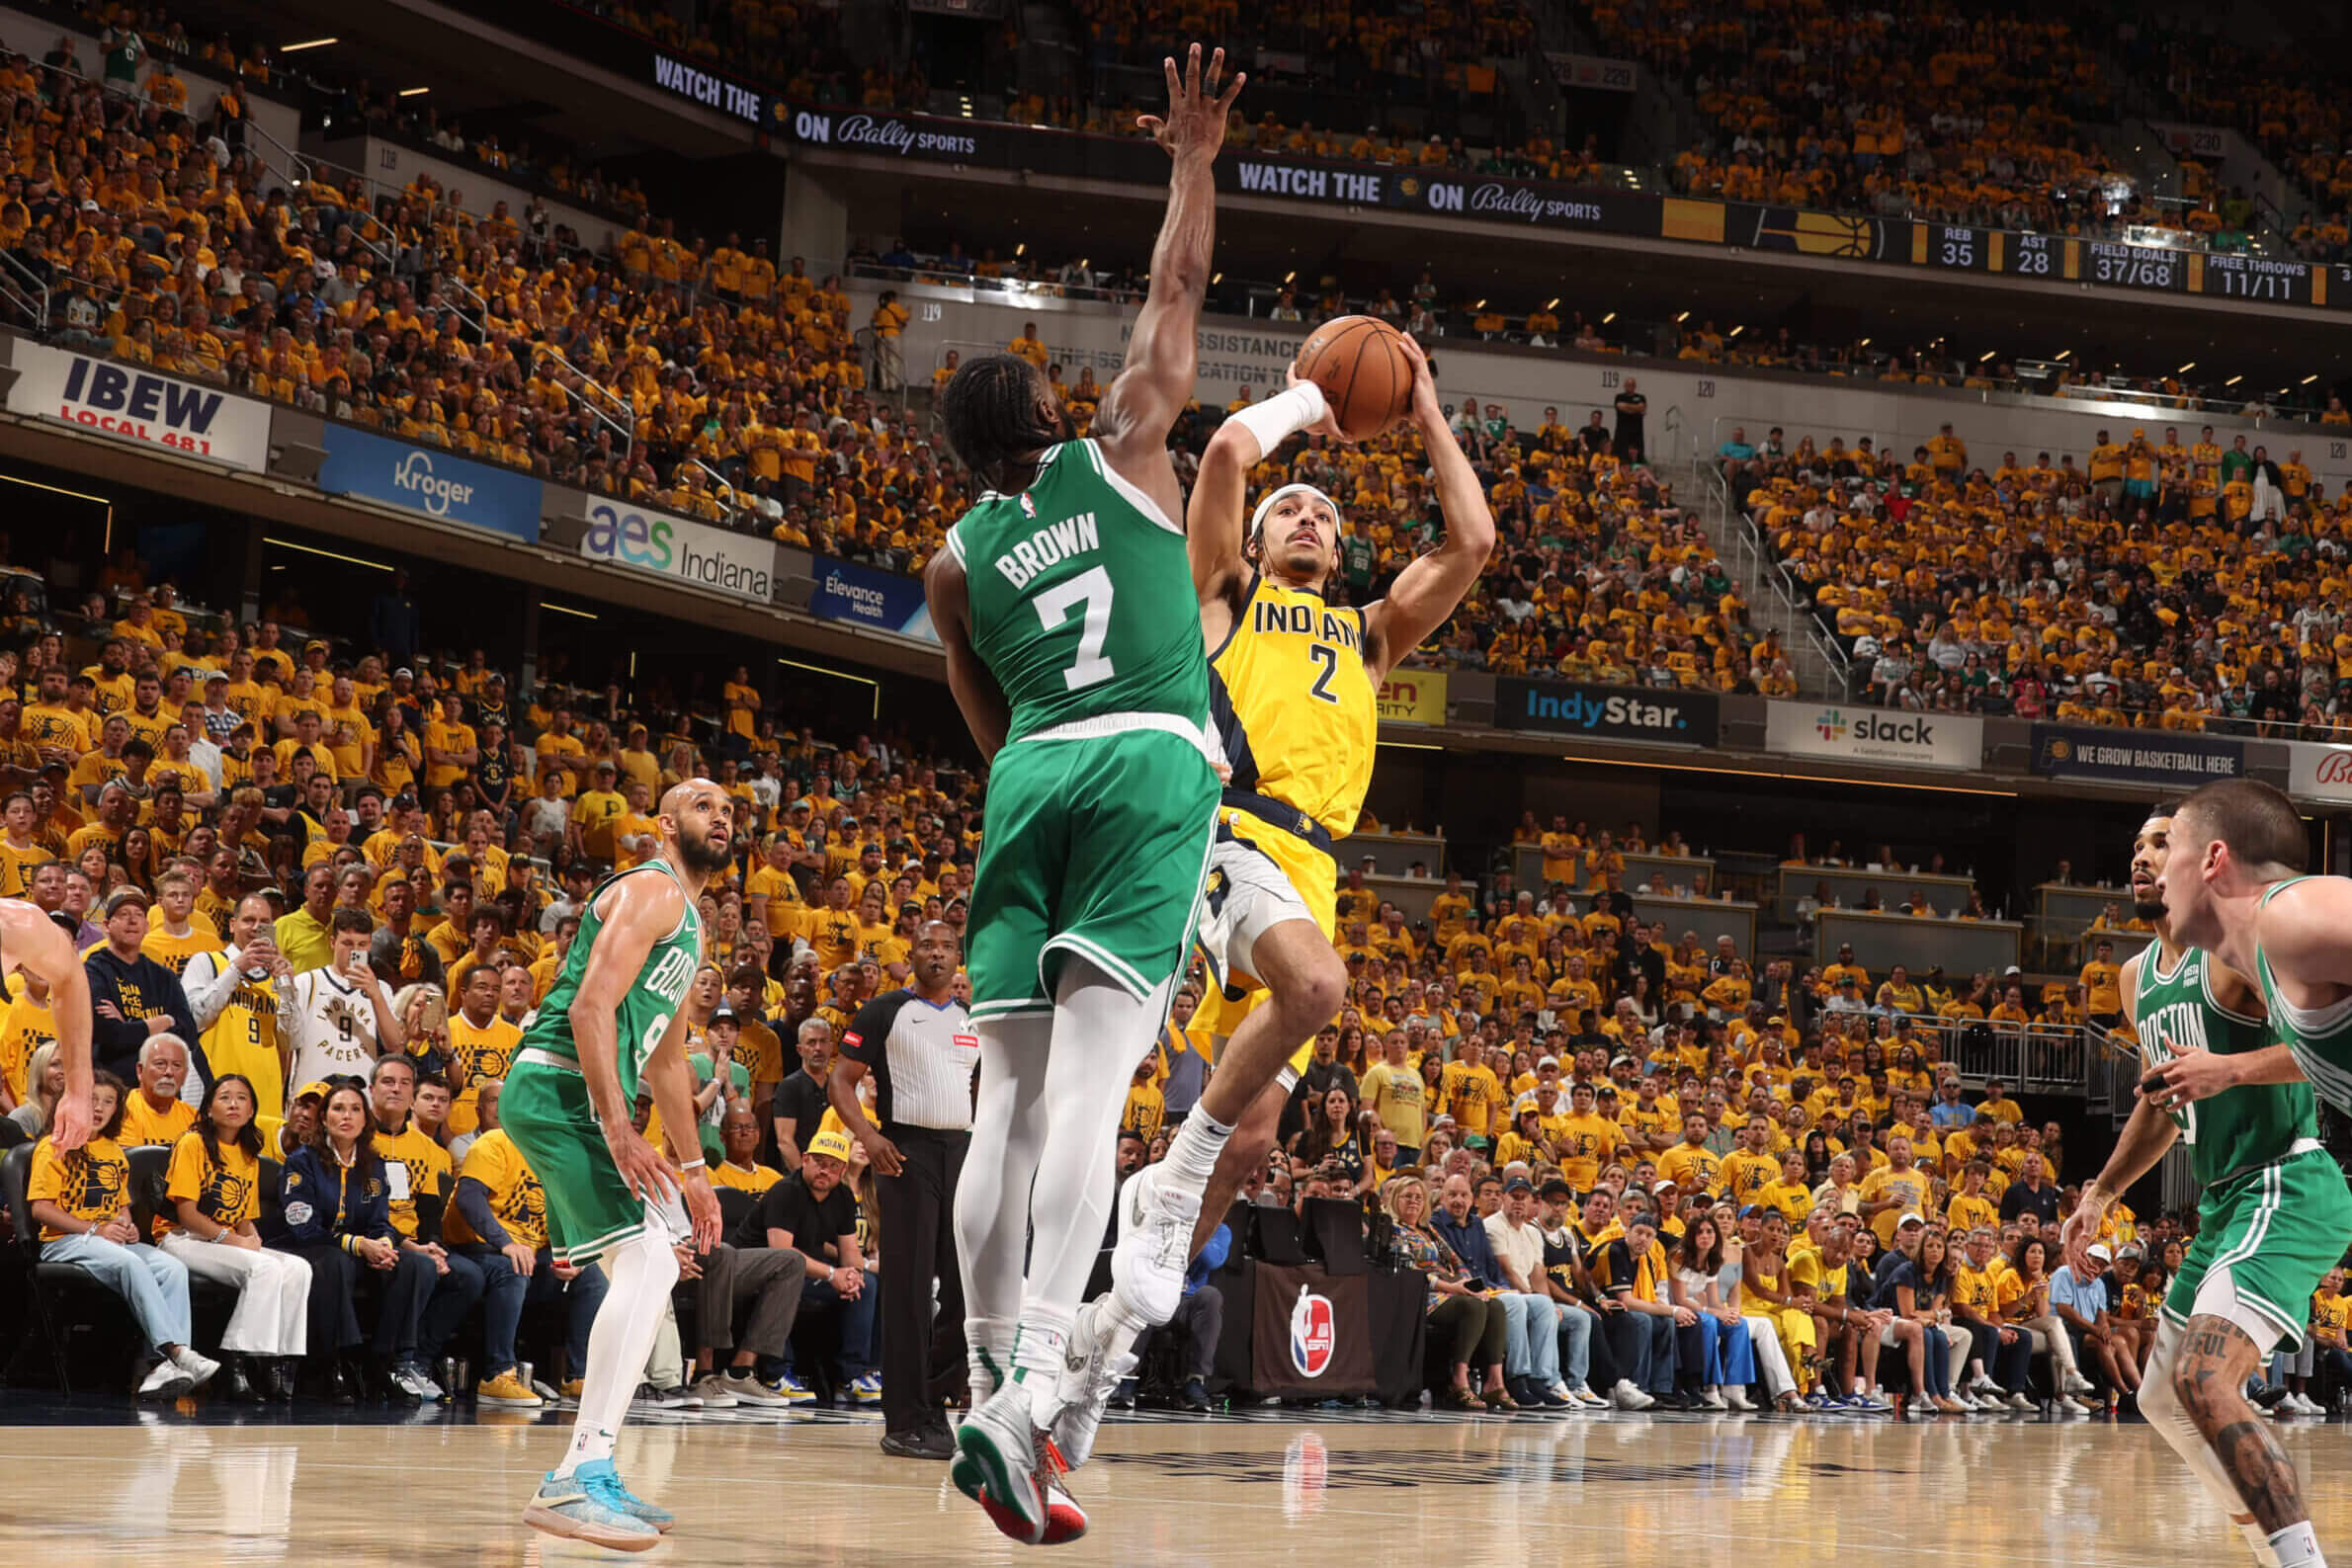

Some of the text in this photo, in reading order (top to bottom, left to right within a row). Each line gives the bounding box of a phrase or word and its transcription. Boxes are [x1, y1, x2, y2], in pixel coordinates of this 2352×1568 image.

[655, 56, 975, 155] WATCH THE ON Bally SPORTS
[1238, 162, 1602, 221] WATCH THE ON Bally SPORTS
[1945, 227, 1973, 242] REB
[2021, 235, 2048, 250] AST
[1942, 242, 1974, 267] 35
[2018, 250, 2049, 275] 28
[2090, 241, 2177, 265] FIELD GOALS
[2210, 254, 2307, 278] FREE THROWS
[2096, 259, 2171, 287] 37/68
[2222, 272, 2293, 301] 11/11
[1602, 371, 1621, 388] 119
[1697, 379, 1716, 398] 120
[63, 357, 224, 435] IBEW
[60, 404, 211, 455] LOCAL 481
[2330, 442, 2347, 459] 120
[393, 451, 474, 516] Kroger
[588, 505, 674, 570] aes
[994, 512, 1100, 591] BROWN
[681, 542, 769, 597] Indiana
[825, 575, 884, 606] Elevance
[852, 601, 883, 619] Health
[1032, 564, 1116, 692] 7
[1309, 643, 1338, 703] 2
[1853, 713, 1934, 745] slack
[2077, 744, 2234, 775] WE GROW BASKETBALL HERE
[316, 997, 372, 1022] INDIANA
[248, 1018, 261, 1044] 9
[339, 1016, 352, 1042] 9
